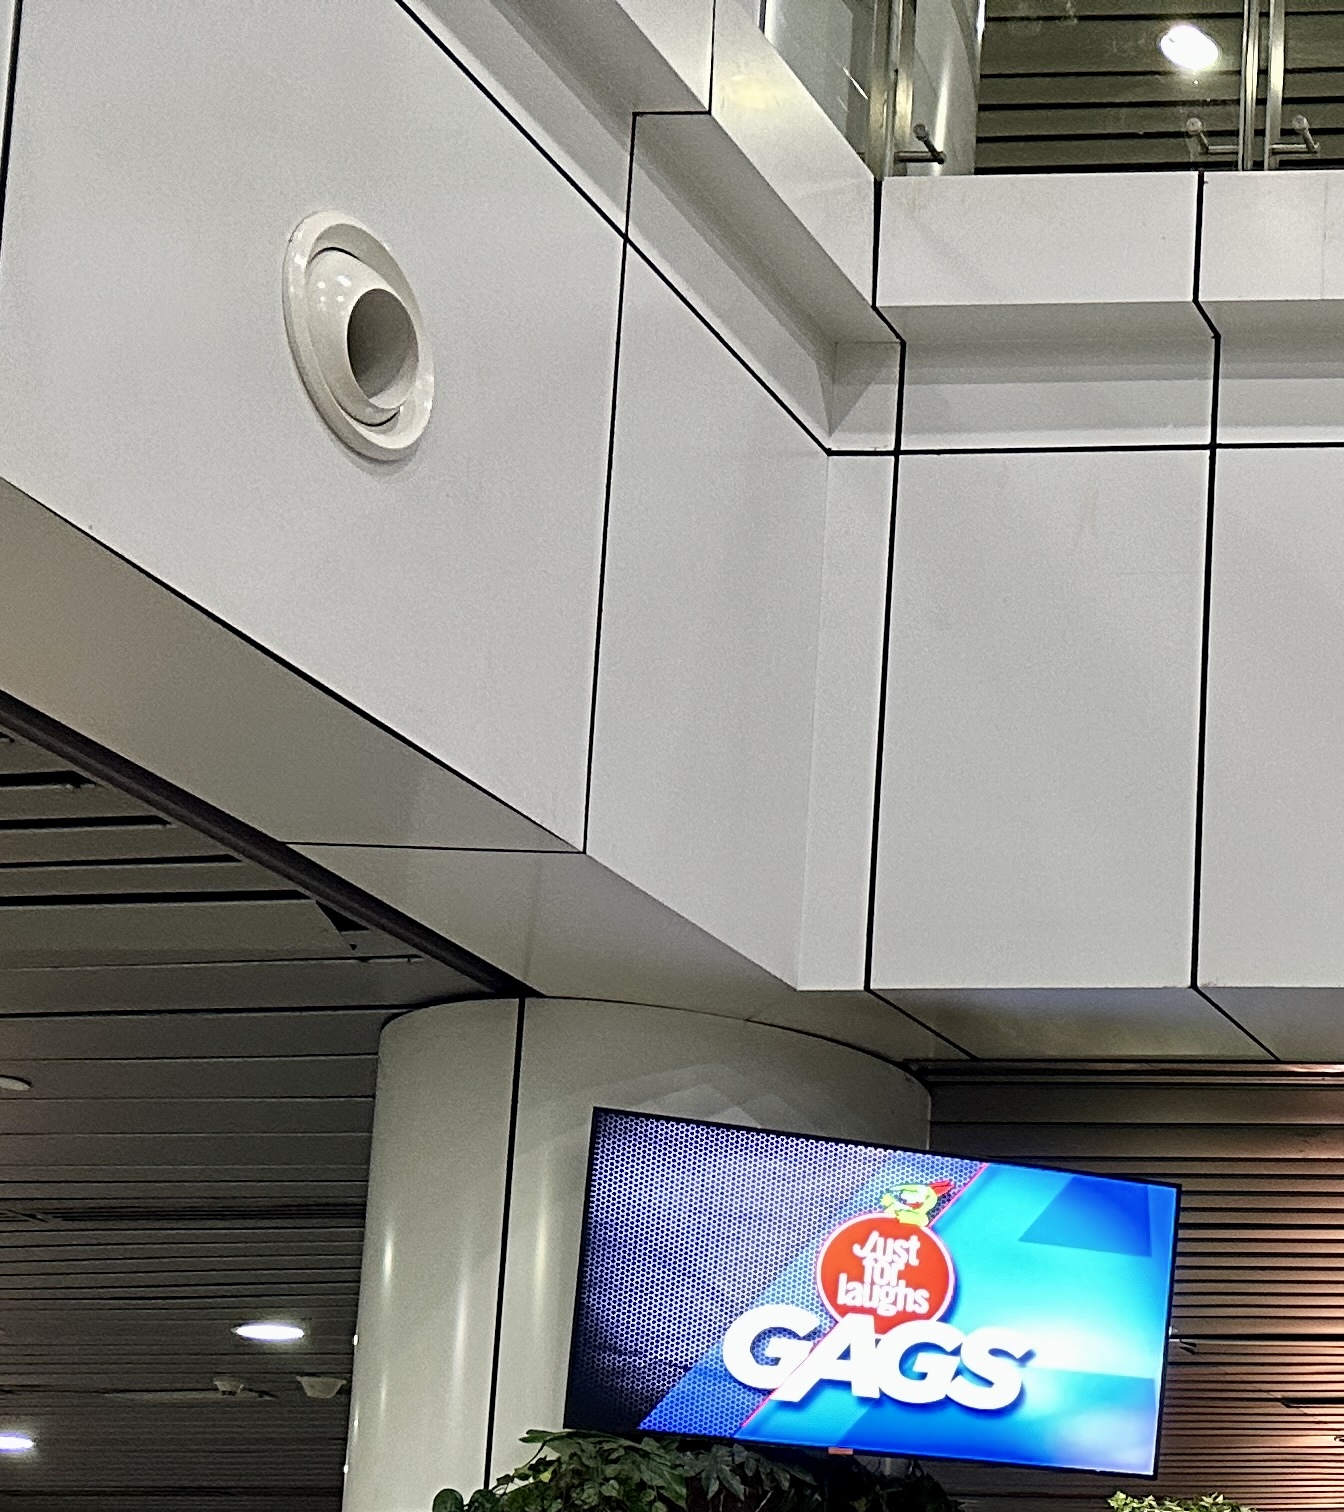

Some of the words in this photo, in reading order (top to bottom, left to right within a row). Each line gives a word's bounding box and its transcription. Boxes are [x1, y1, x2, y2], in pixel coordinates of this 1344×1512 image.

[852, 1230, 921, 1267] Just
[862, 1257, 902, 1287] for
[836, 1273, 931, 1317] laughs
[722, 1303, 1034, 1411] GAGS
